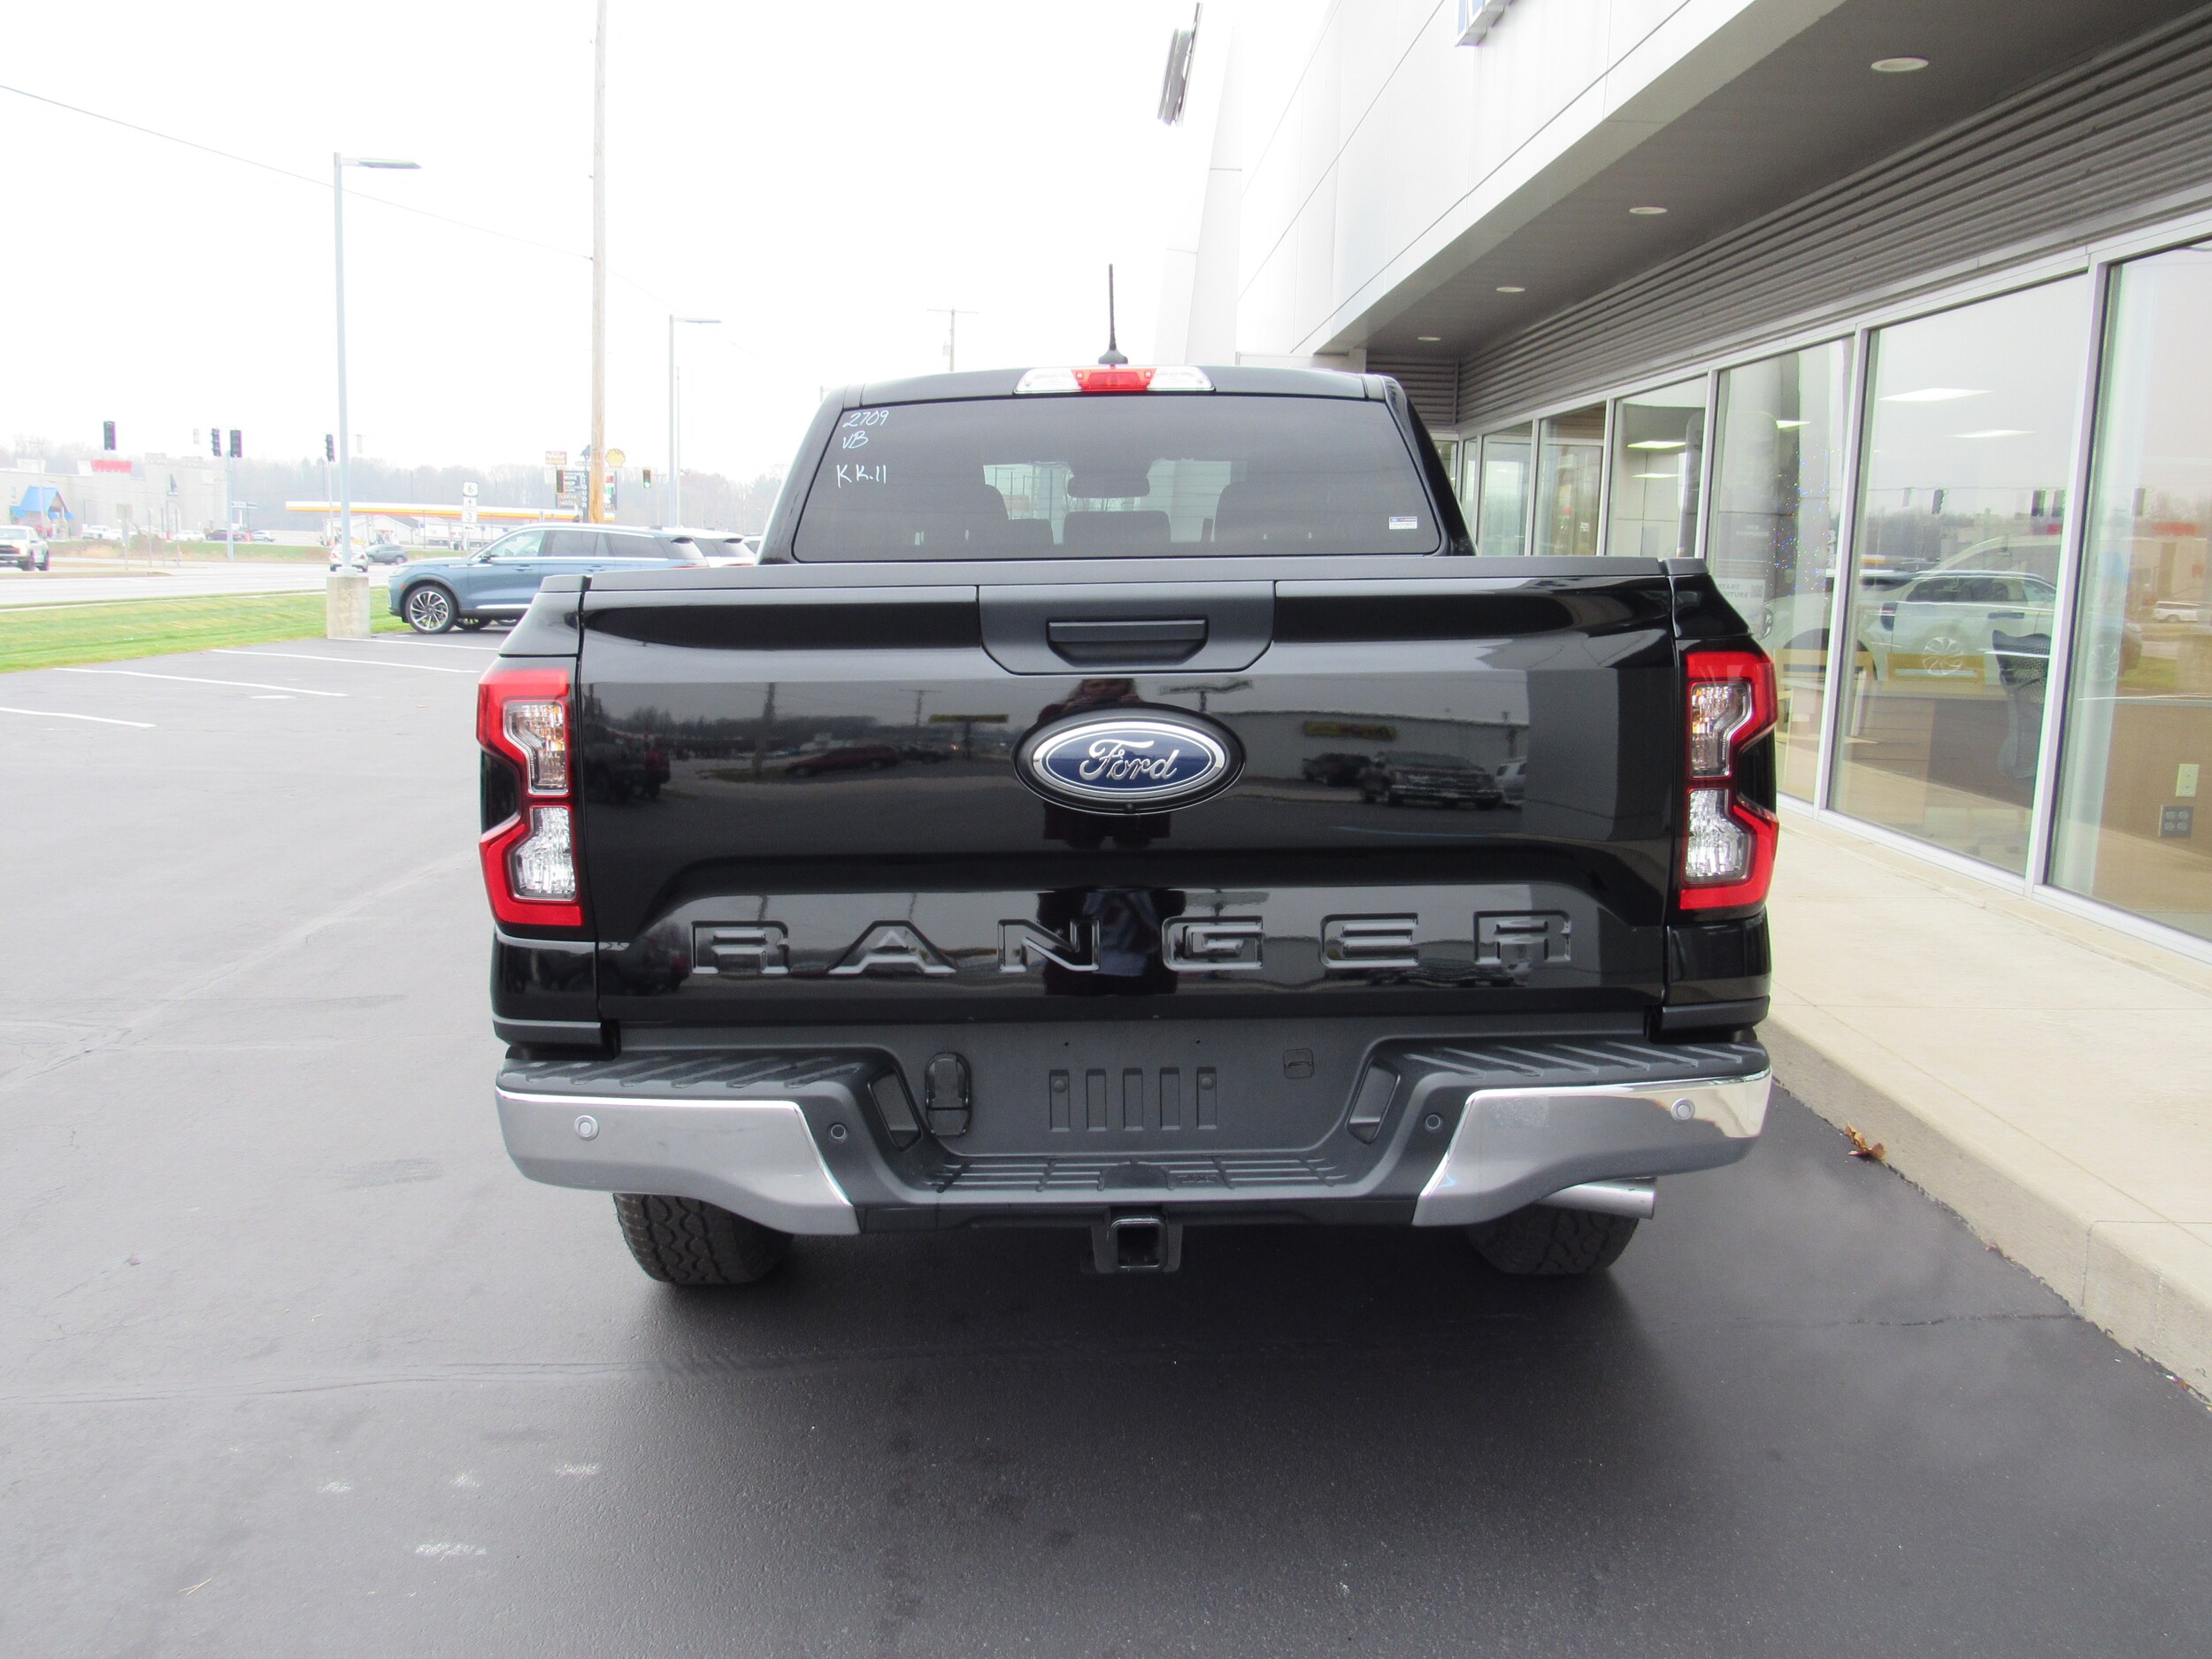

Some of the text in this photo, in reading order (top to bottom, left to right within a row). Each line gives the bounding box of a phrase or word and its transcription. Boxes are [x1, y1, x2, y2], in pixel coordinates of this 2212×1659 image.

[842, 410, 889, 428] 2709
[467, 484, 474, 494] 6
[466, 512, 472, 521] 3
[1079, 739, 1180, 781] Ford
[692, 910, 1571, 973] RANGER
